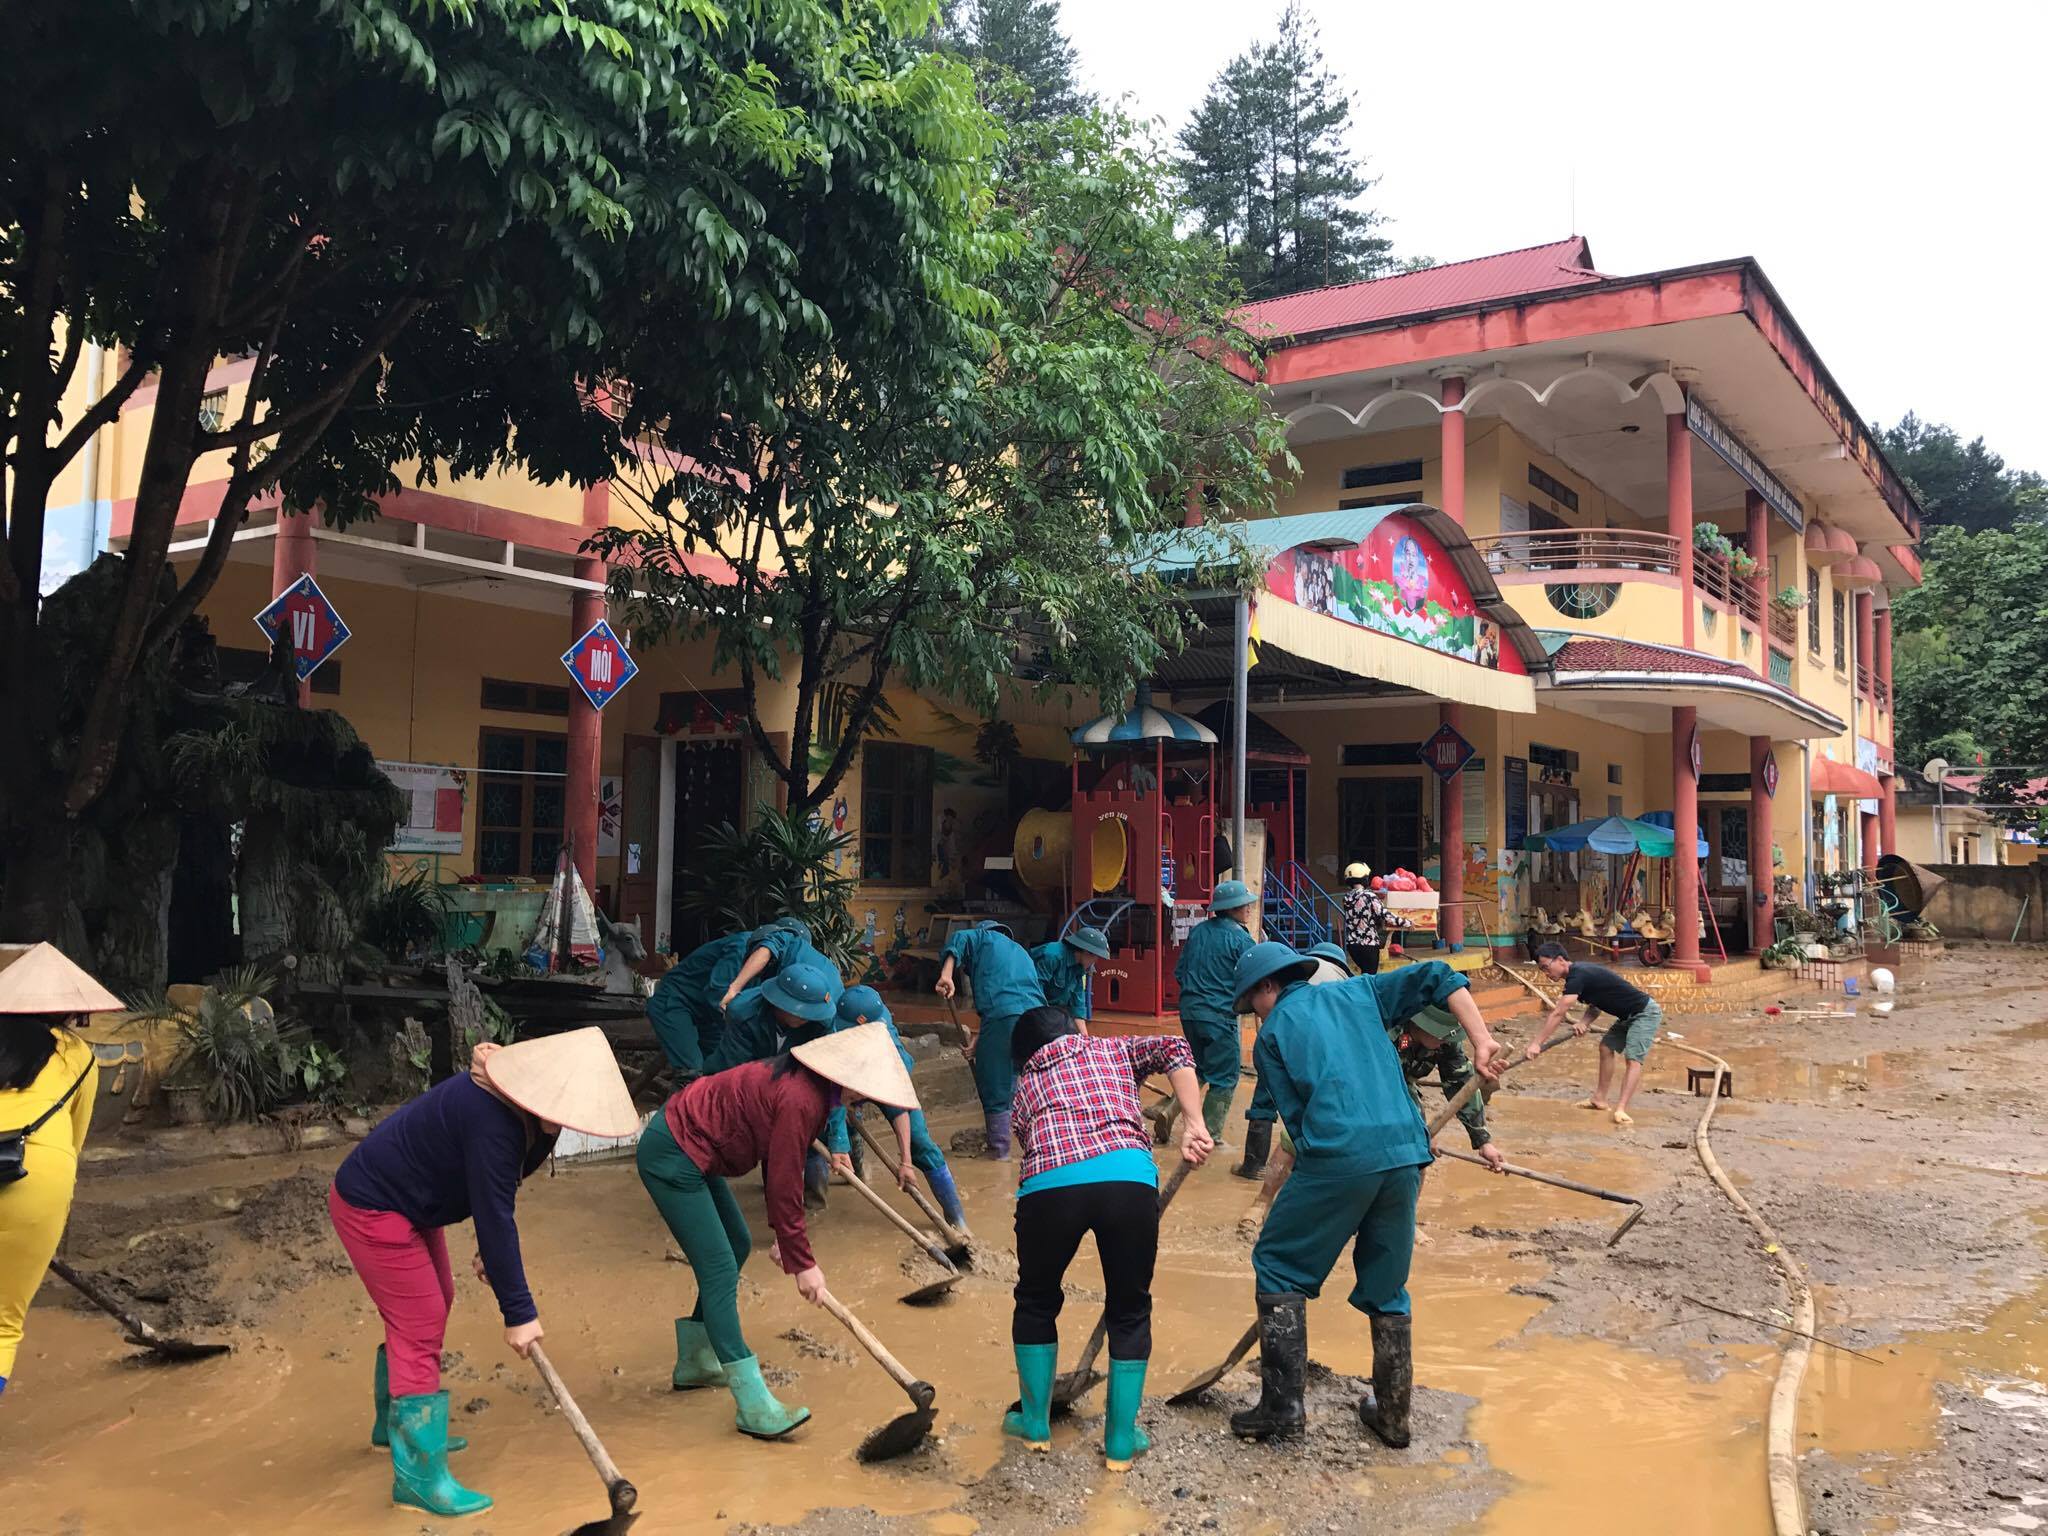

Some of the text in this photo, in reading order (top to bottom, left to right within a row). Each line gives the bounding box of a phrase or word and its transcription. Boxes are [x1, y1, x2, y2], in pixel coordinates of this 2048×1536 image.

[292, 604, 316, 651] VÌ
[590, 643, 613, 684] MÔI
[1436, 742, 1457, 765] XANH
